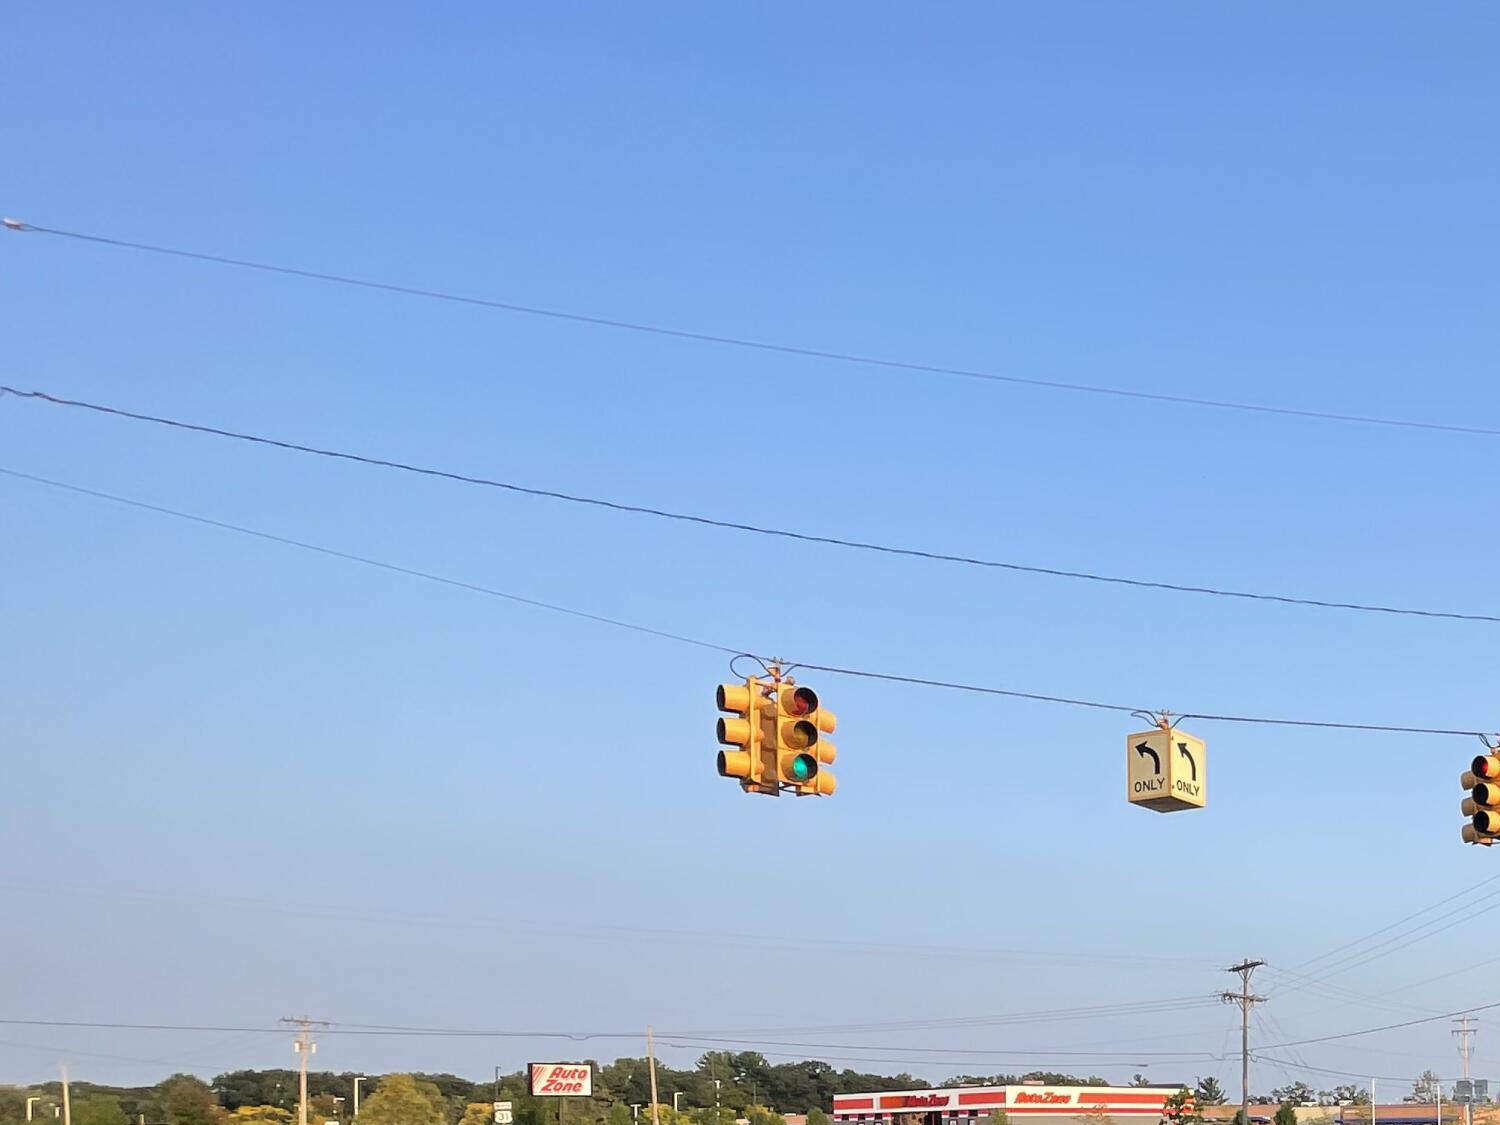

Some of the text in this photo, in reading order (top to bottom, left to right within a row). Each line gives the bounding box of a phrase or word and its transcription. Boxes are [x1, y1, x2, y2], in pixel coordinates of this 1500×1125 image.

[1134, 777, 1165, 793] ONLY
[1176, 779, 1200, 797] ONLY
[549, 1066, 588, 1079] Auto
[541, 1079, 583, 1092] Zone
[1014, 1091, 1072, 1104] AutoZone
